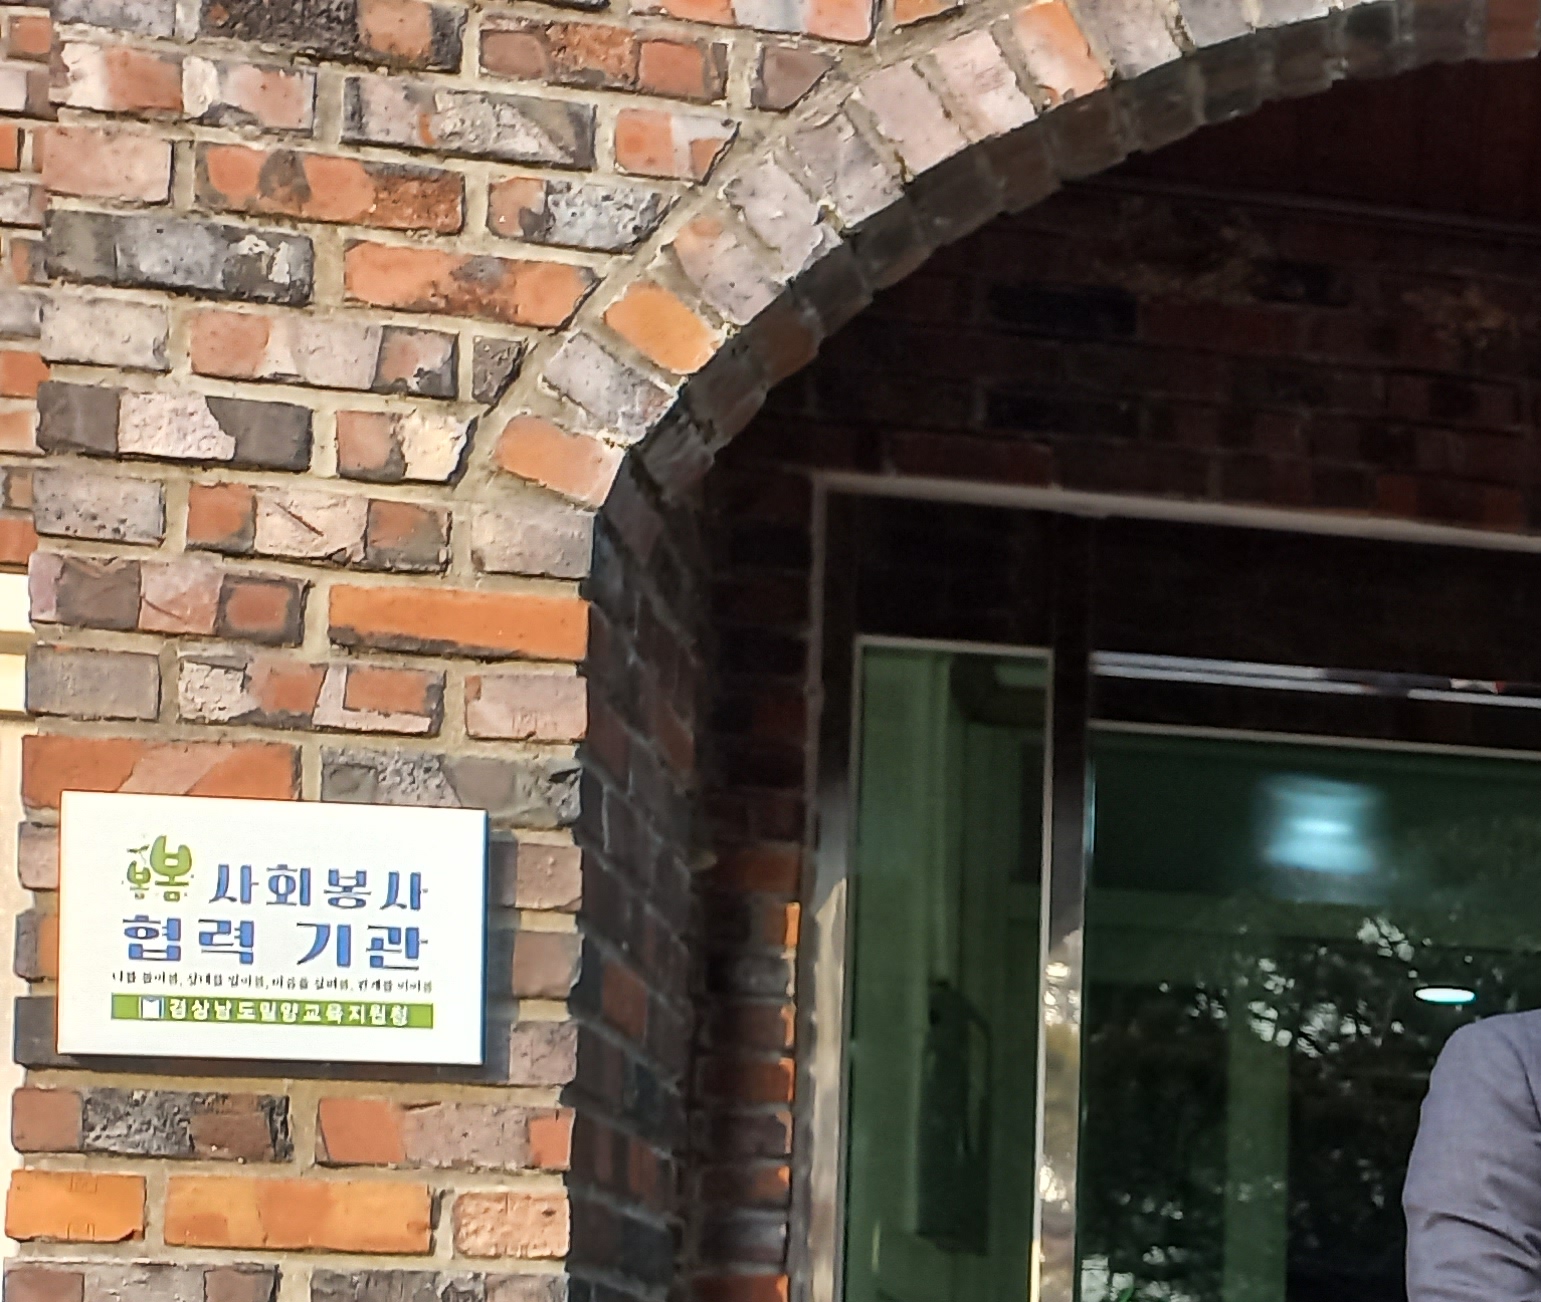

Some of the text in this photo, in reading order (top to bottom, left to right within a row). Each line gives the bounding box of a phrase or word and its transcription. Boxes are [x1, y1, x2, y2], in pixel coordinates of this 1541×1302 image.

[208, 864, 430, 911] 사회봉사
[122, 914, 428, 970] 협력 기관
